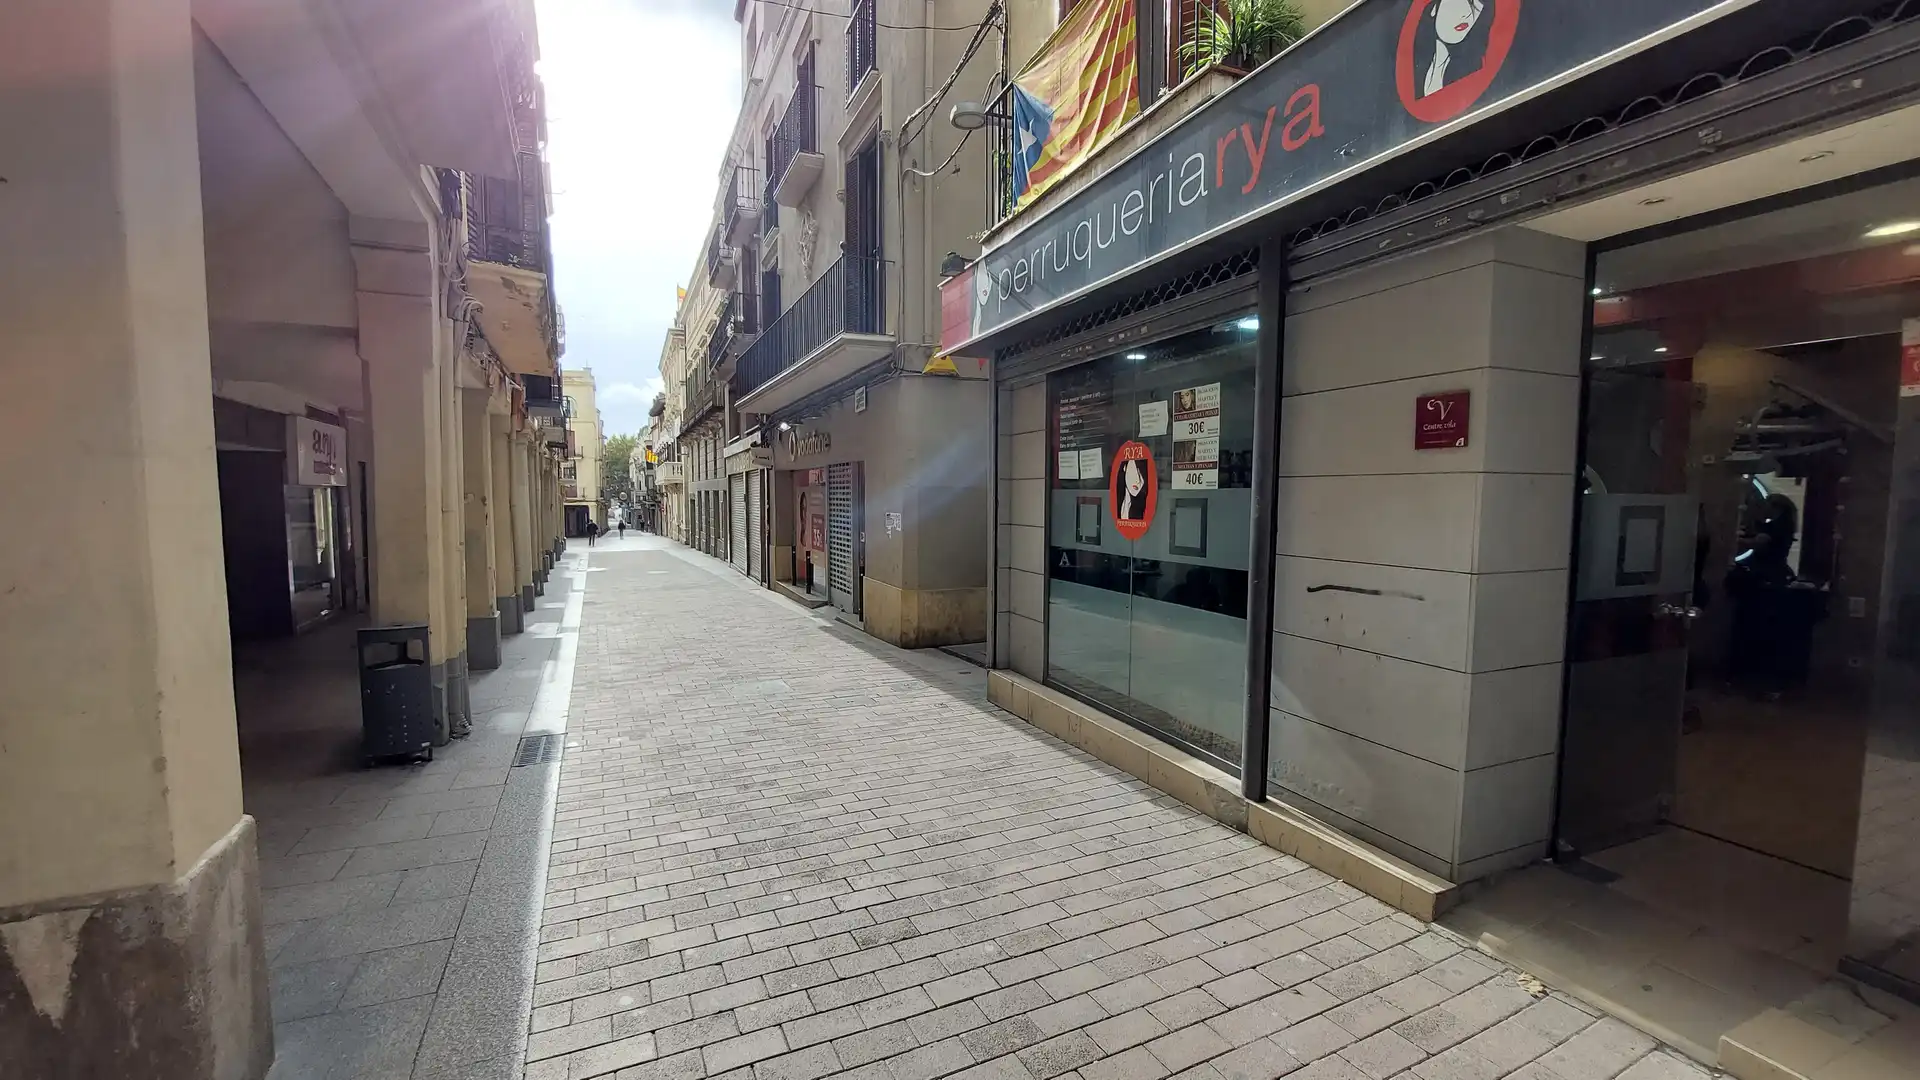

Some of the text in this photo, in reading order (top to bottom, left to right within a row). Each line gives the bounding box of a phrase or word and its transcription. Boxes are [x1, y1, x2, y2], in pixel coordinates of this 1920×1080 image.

[998, 83, 1326, 314] perruqueria rya
[1188, 421, 1205, 435] 30€
[1423, 423, 1443, 431] Centre
[797, 430, 831, 457] vodafone
[1124, 446, 1144, 460] RYA
[1185, 472, 1204, 485] 40€
